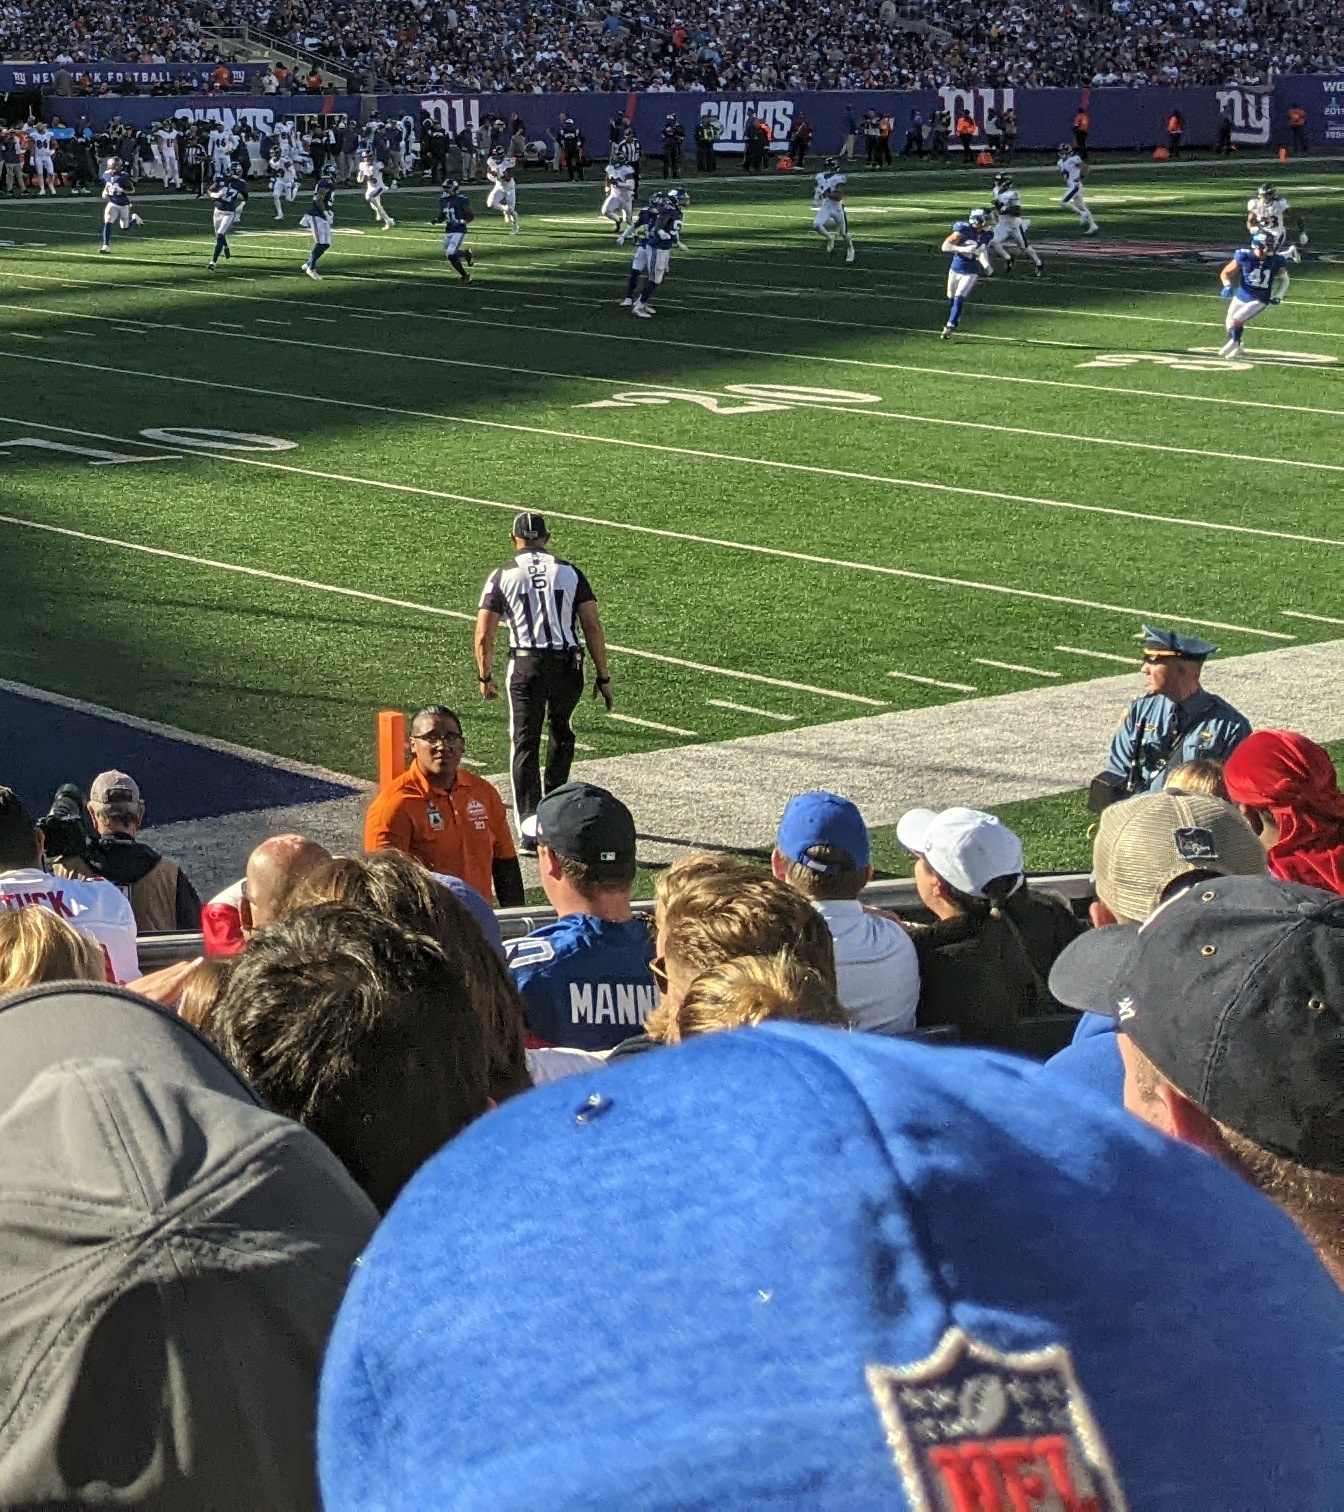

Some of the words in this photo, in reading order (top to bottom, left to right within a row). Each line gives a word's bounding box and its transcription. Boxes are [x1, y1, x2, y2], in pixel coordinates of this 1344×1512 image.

[1216, 89, 1271, 144] ny
[1250, 268, 1271, 290] 41
[927, 1433, 1100, 1512] NFL
